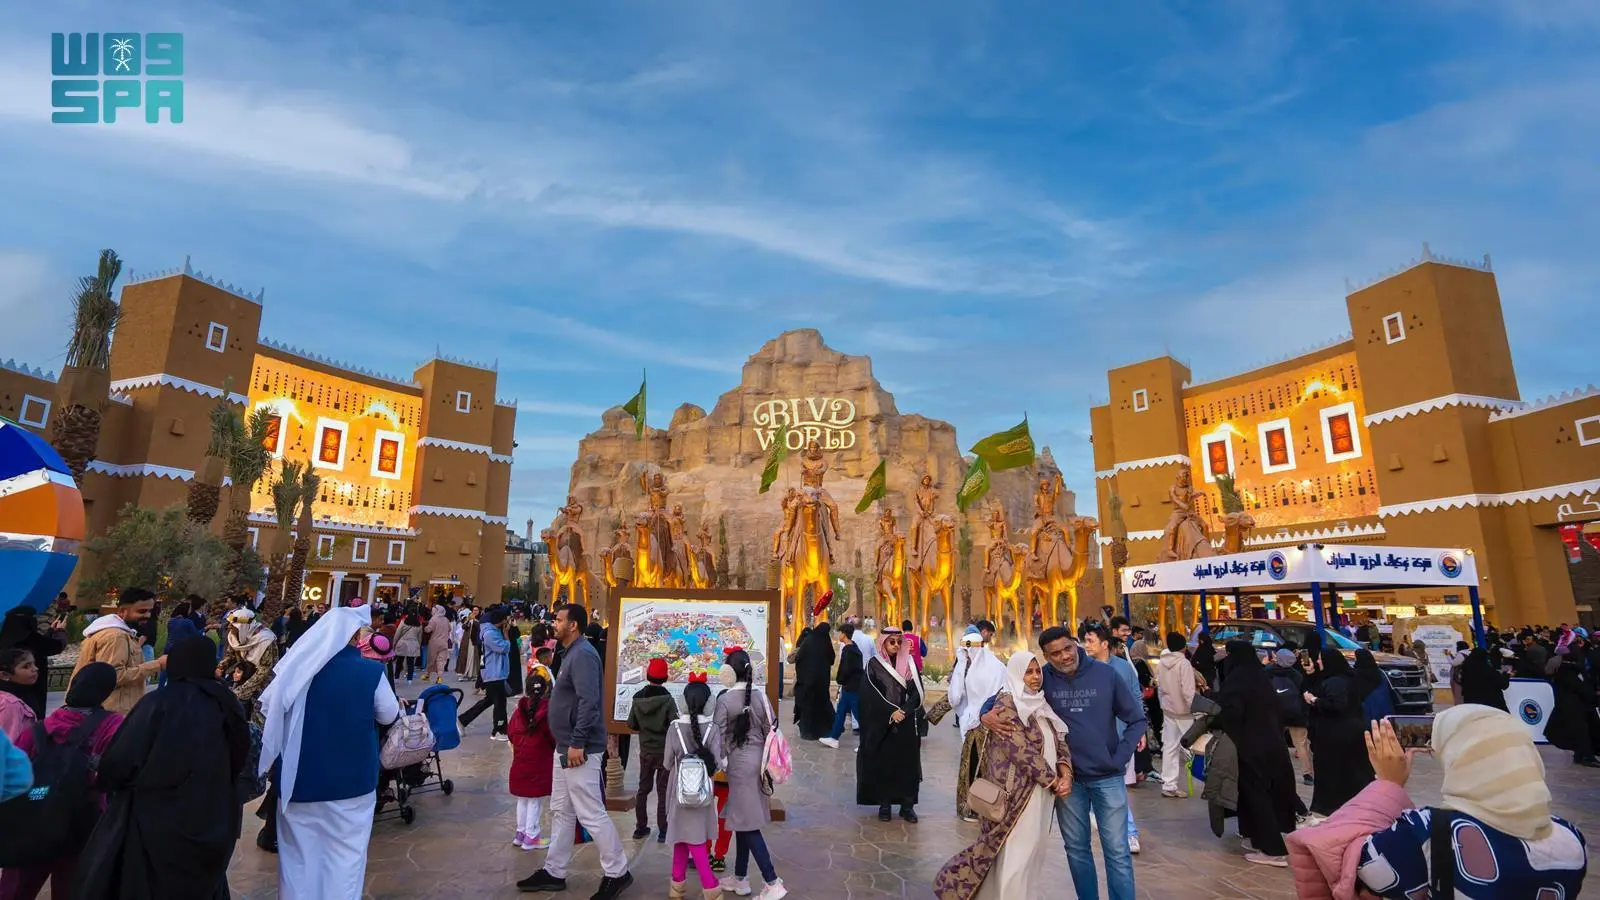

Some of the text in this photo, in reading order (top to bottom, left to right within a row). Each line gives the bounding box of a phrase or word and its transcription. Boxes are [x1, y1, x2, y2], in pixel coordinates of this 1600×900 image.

[753, 397, 856, 429] BLVD
[753, 426, 856, 451] WORLD
[1131, 570, 1156, 588] Ford
[301, 583, 322, 601] tc
